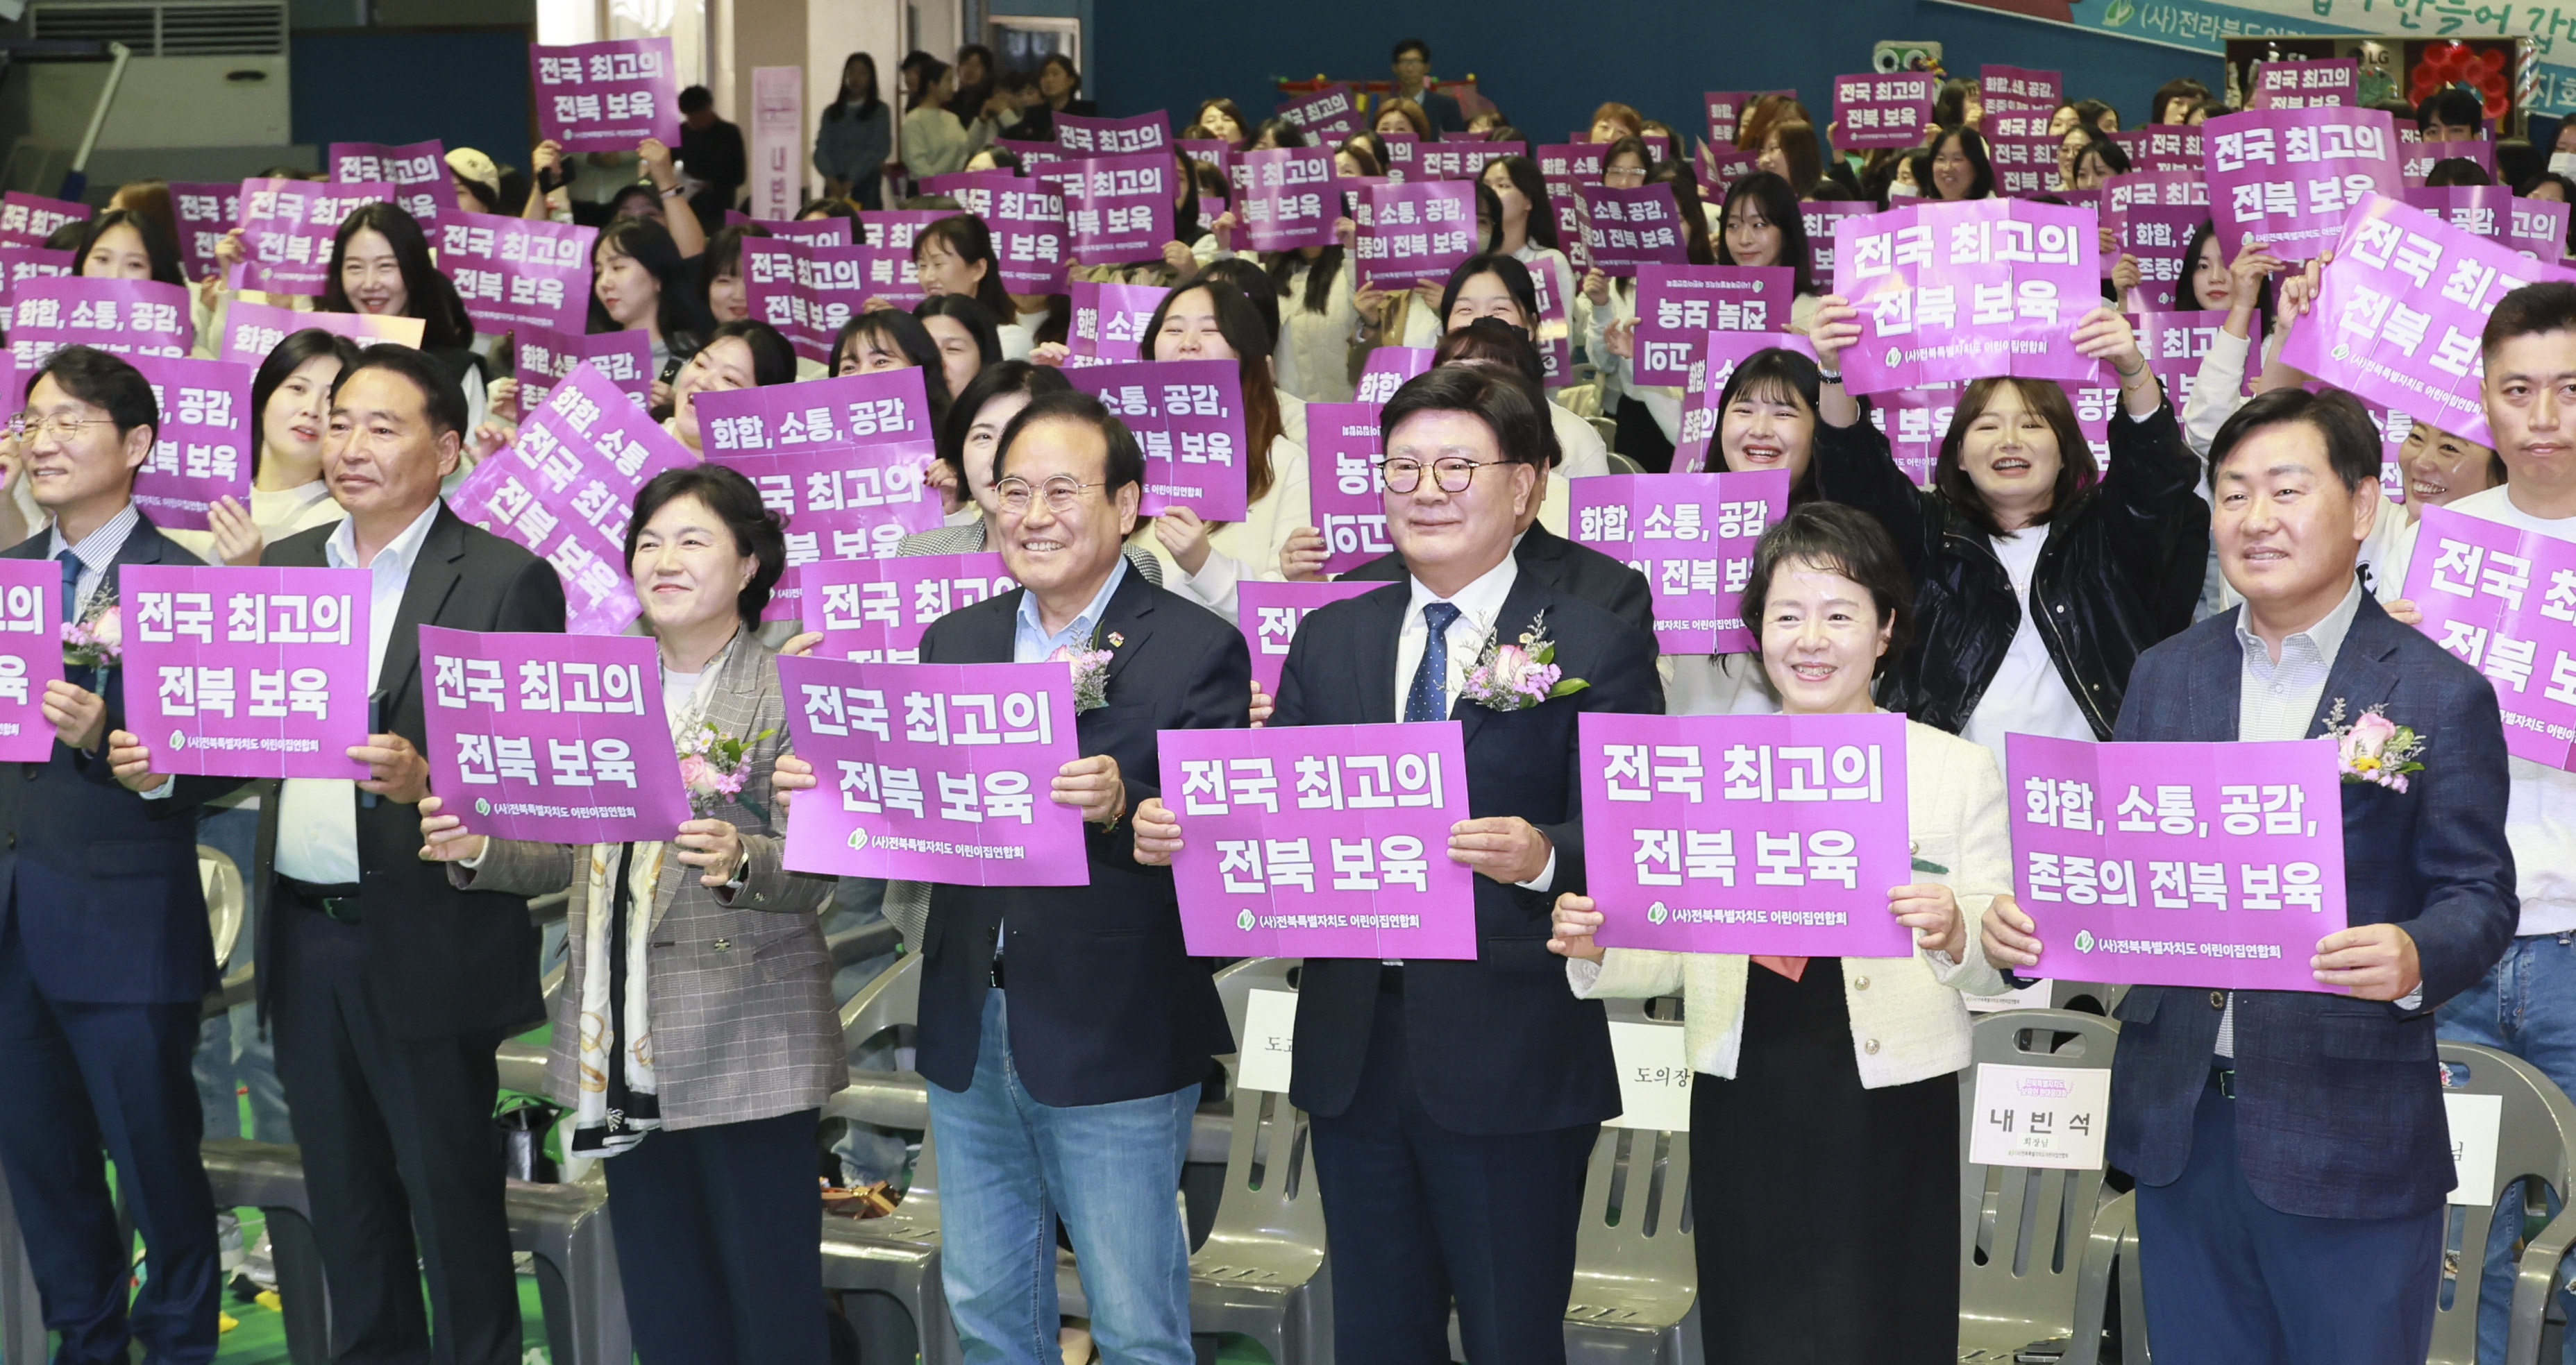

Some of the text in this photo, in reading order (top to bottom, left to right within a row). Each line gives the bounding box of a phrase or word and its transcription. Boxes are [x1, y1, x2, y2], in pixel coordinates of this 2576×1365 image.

[538, 51, 664, 84] 전국 최고의
[2266, 67, 2350, 90] 전국 최고의
[554, 91, 655, 123] 전북 보육
[1840, 80, 1926, 103] 전국 최고의
[1847, 107, 1917, 128] 전북 보육
[1998, 118, 2026, 136] 전국
[1060, 124, 1163, 152] 전국 최고의
[1995, 144, 2028, 164] 전국
[2152, 134, 2181, 155] 전국
[2214, 124, 2386, 172] 전국 최고의
[338, 155, 382, 183] 전국
[1262, 158, 1329, 186] 최고의
[1424, 153, 1460, 173] 전국
[1093, 167, 1161, 197] 최고의
[2005, 171, 2039, 192] 전북
[2111, 183, 2157, 212] 전국
[178, 195, 220, 221] 전국
[249, 191, 304, 223] 전국
[999, 191, 1064, 222] 최고의
[1108, 205, 1153, 232] 보육
[1279, 194, 1321, 220] 보육
[1379, 198, 1466, 224] 소통, 공감,
[1628, 199, 1667, 222] 공감,
[2232, 180, 2298, 223] 전북
[258, 231, 312, 264] 전북
[444, 225, 584, 269] 전국 최고의
[1009, 233, 1059, 264] 보육
[1393, 230, 1468, 257] 전북 보육
[1641, 227, 1676, 248] 보육
[1853, 219, 2080, 279] 전국 최고의
[2136, 222, 2177, 248] 화합,
[2350, 216, 2443, 289] 전국
[453, 267, 565, 310] 전북 보육
[750, 252, 861, 291] 전국 최고의
[17, 298, 65, 330] 화합,
[71, 300, 125, 332] 소통,
[131, 301, 183, 335] 공감,
[764, 295, 808, 328] 전북
[1873, 279, 2060, 337] 전북 보육
[2339, 285, 2432, 358] 전북
[521, 344, 553, 378] 화합,
[178, 387, 238, 430] 공감,
[1164, 384, 1228, 418] 공감,
[550, 384, 650, 486] 화합, 소통,
[710, 396, 915, 450] 화합, 소통, 공감,
[186, 442, 238, 482] 보육
[513, 421, 584, 494] 전국
[1181, 432, 1234, 468] 보육
[807, 462, 923, 512] 최고의
[1580, 505, 1635, 543] 화합,
[1644, 503, 1710, 542] 소통,
[486, 475, 620, 608] 전북 보육
[1662, 559, 1717, 595] 전북
[2430, 537, 2532, 611] 전국
[136, 592, 352, 645] 전국 최고의
[822, 581, 901, 631] 전국
[158, 666, 330, 720] 전북 보육
[434, 654, 646, 715] 전국 최고의
[801, 684, 1053, 746] 전국 최고의
[260, 737, 319, 752] 어린이집연합회
[455, 733, 637, 788] 전북 보육
[1181, 752, 1444, 816] 전국 최고의
[1603, 744, 1883, 803] 전국 최고의
[836, 760, 1034, 824] 전북 보육
[2024, 776, 2318, 838] 화합, 소통, 공감,
[494, 802, 637, 819] (사)전북특별자치도 어린이집연합회
[871, 835, 1025, 860] (사)전북특별자치도 어린이집연합회
[1215, 835, 1428, 894] 전북 보육
[1633, 829, 1859, 889] 전북 보육
[2028, 851, 2323, 913] 존중의 전북 보육
[1259, 914, 1420, 929] (사)전북특별자치도 어린이집연합회
[1672, 908, 1848, 926] (사)전북특별자치도 어린이집연합회
[2098, 938, 2282, 959] (사)전북특별자치도 어린이집연합회
[1634, 1067, 1694, 1087] 도의장
